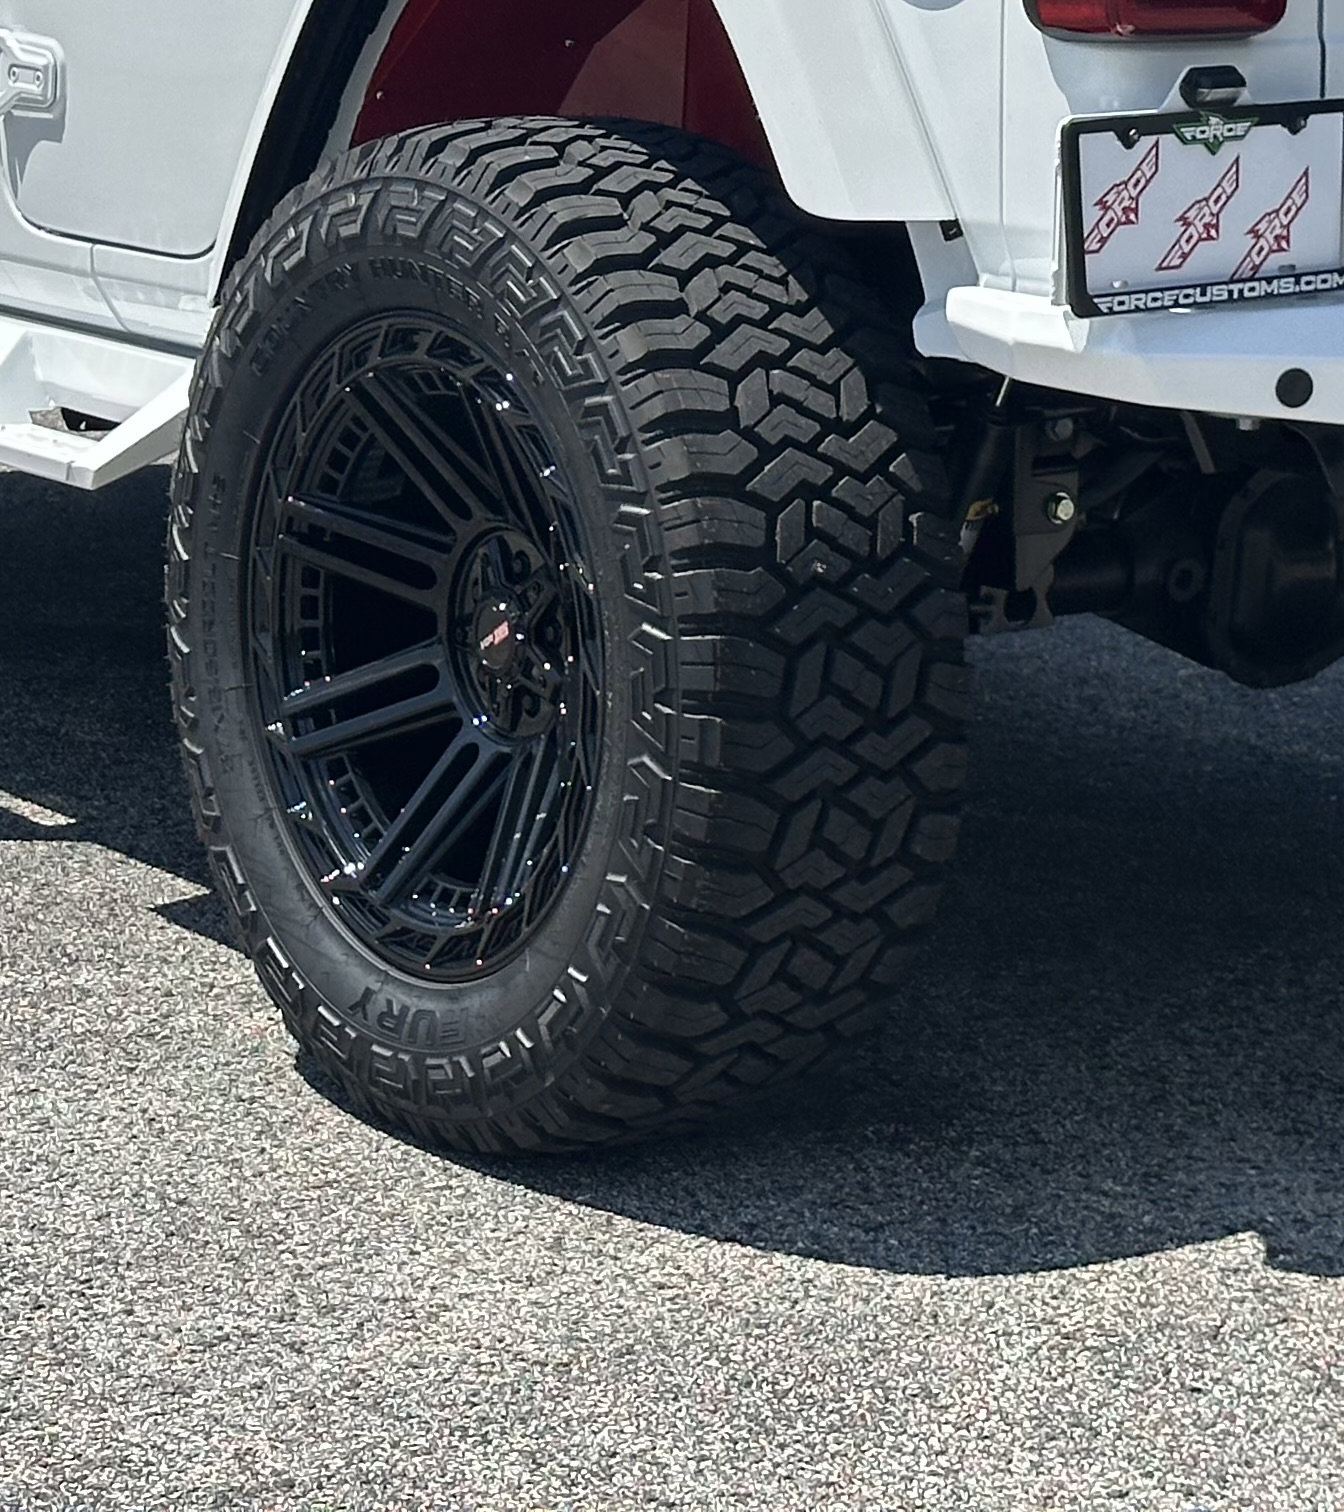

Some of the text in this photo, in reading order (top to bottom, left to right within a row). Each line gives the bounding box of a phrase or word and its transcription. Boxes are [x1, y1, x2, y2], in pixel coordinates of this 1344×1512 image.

[1180, 116, 1252, 143] FORCE
[367, 255, 485, 321] HUNTER
[346, 981, 469, 1047] FURY
